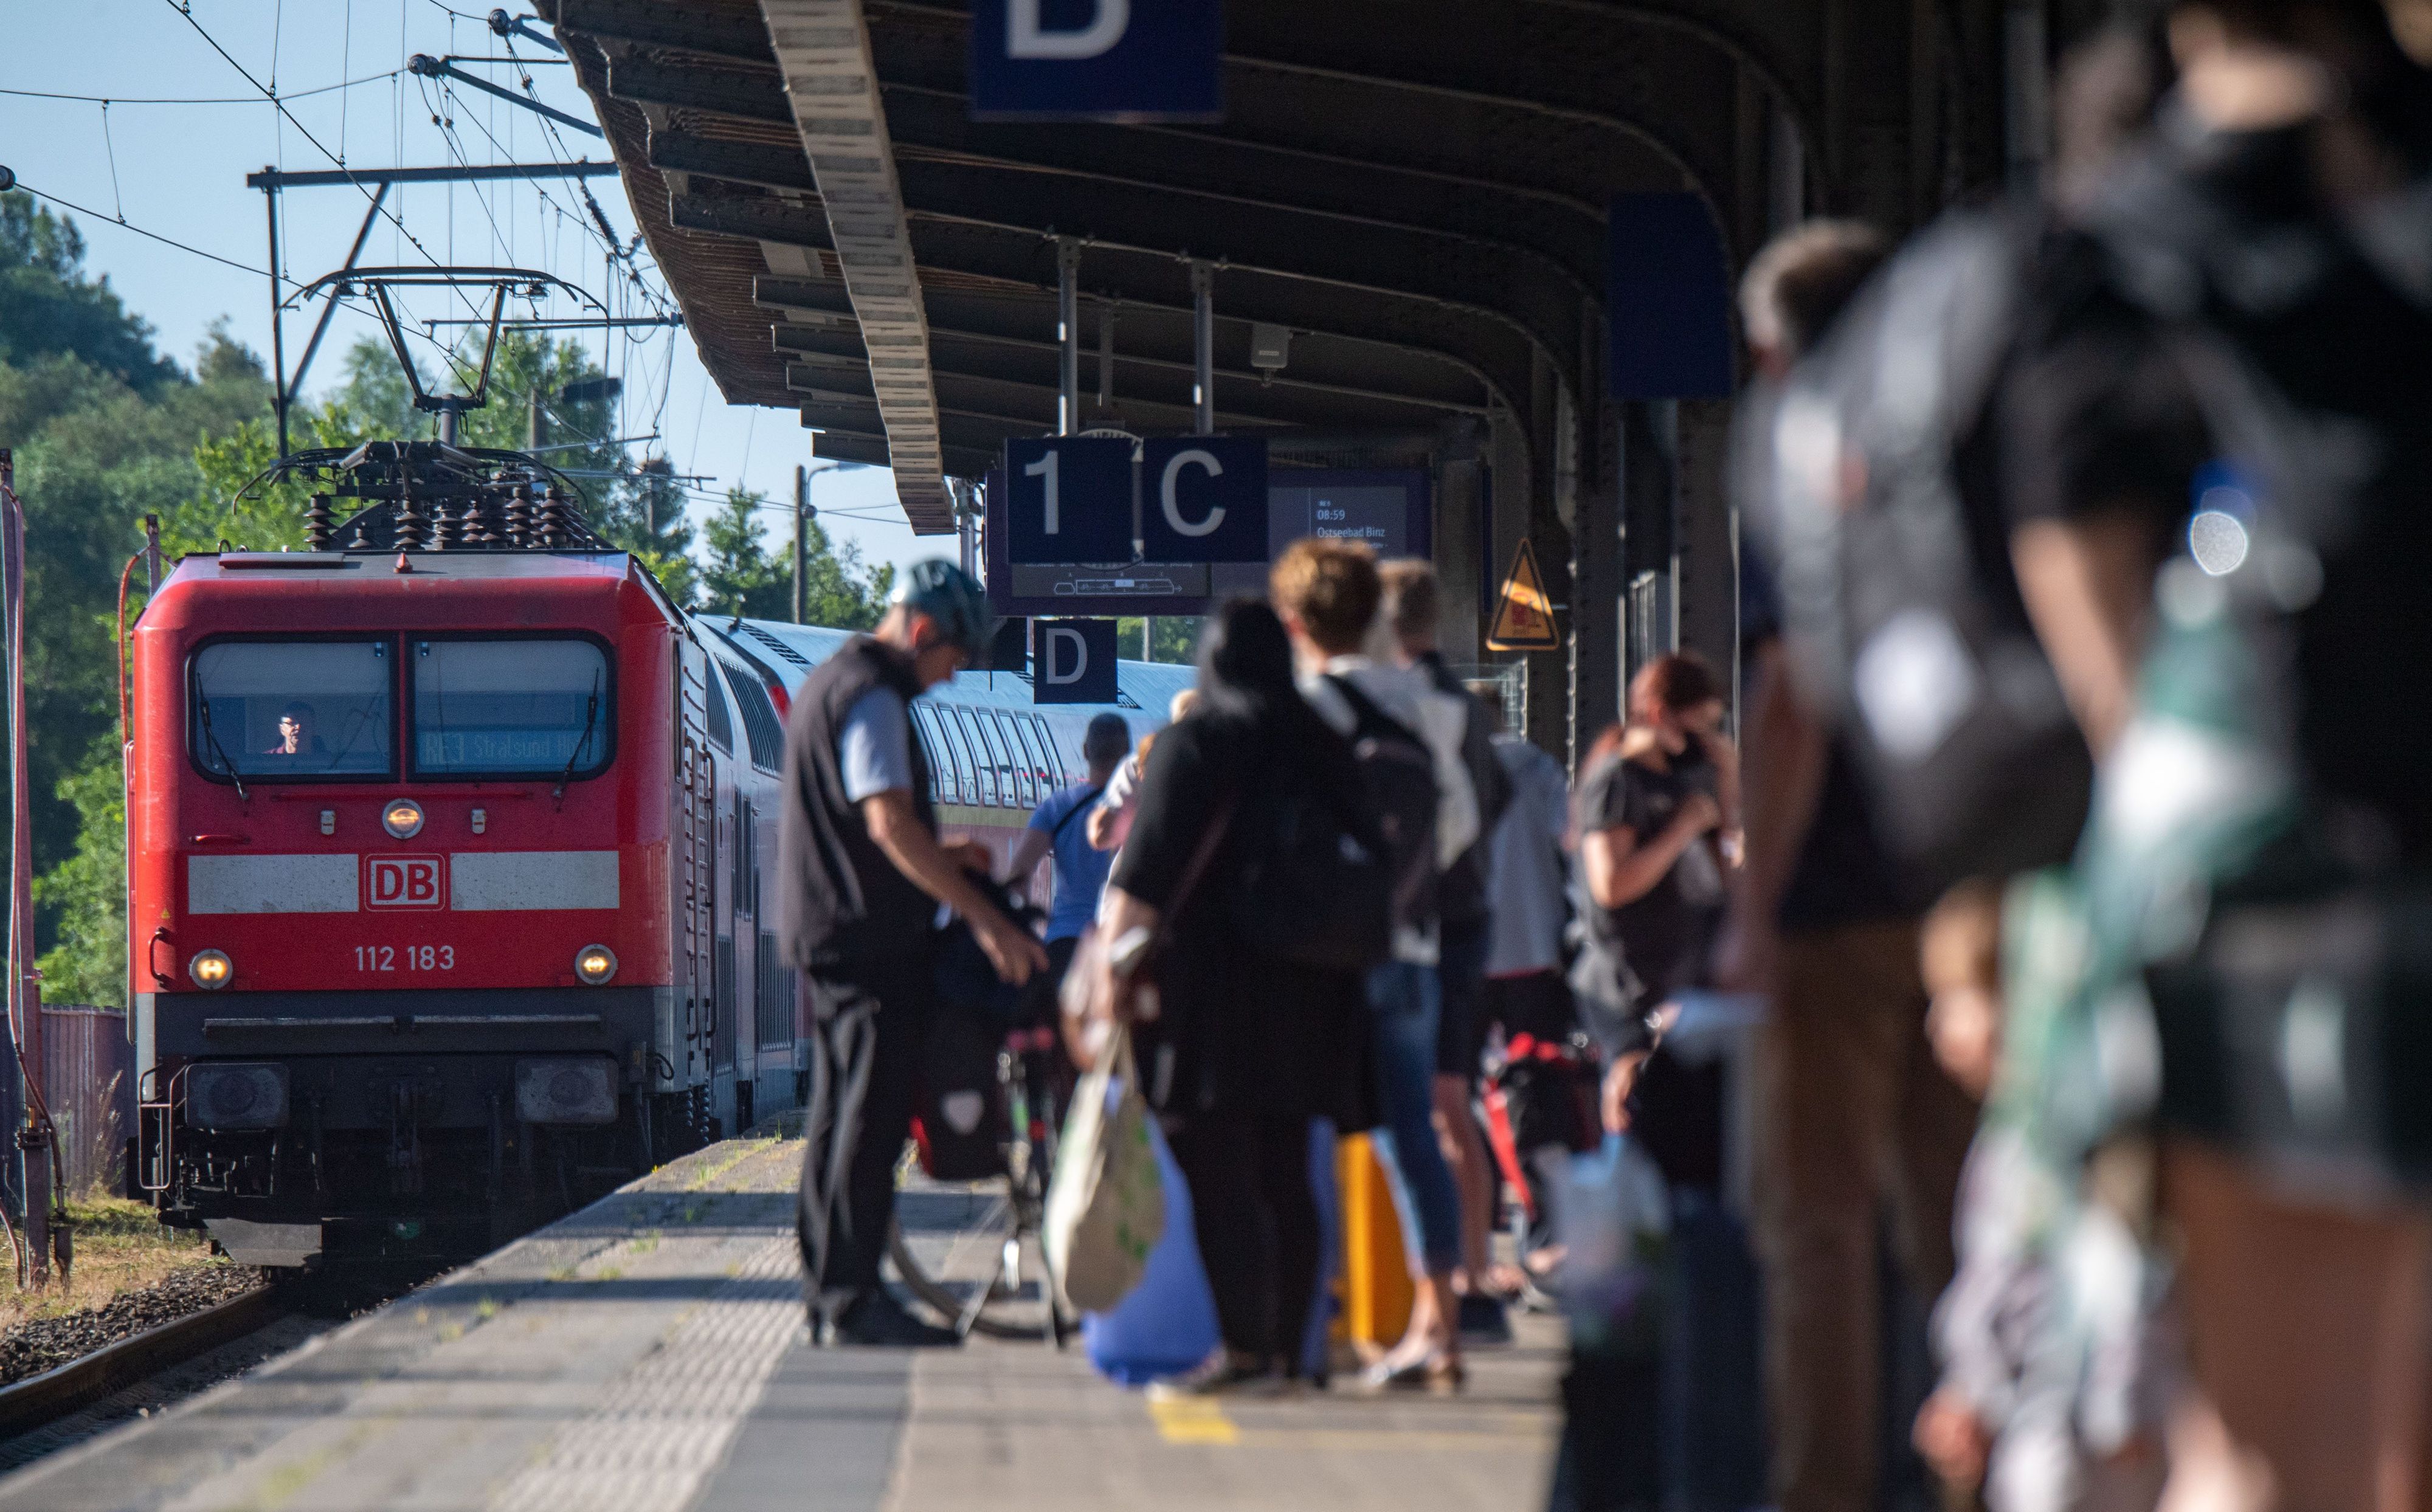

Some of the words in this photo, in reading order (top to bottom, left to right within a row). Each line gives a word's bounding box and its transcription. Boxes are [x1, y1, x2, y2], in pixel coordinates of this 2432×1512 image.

[1024, 449, 1059, 535] 1
[1160, 449, 1226, 536] C
[1317, 509, 1346, 520] 08:59
[1317, 527, 1364, 538] Ostseebad
[1367, 527, 1386, 537] Binz
[1046, 628, 1088, 684] D
[376, 864, 435, 900] DB
[355, 946, 395, 971] 112
[407, 945, 454, 970] 183
